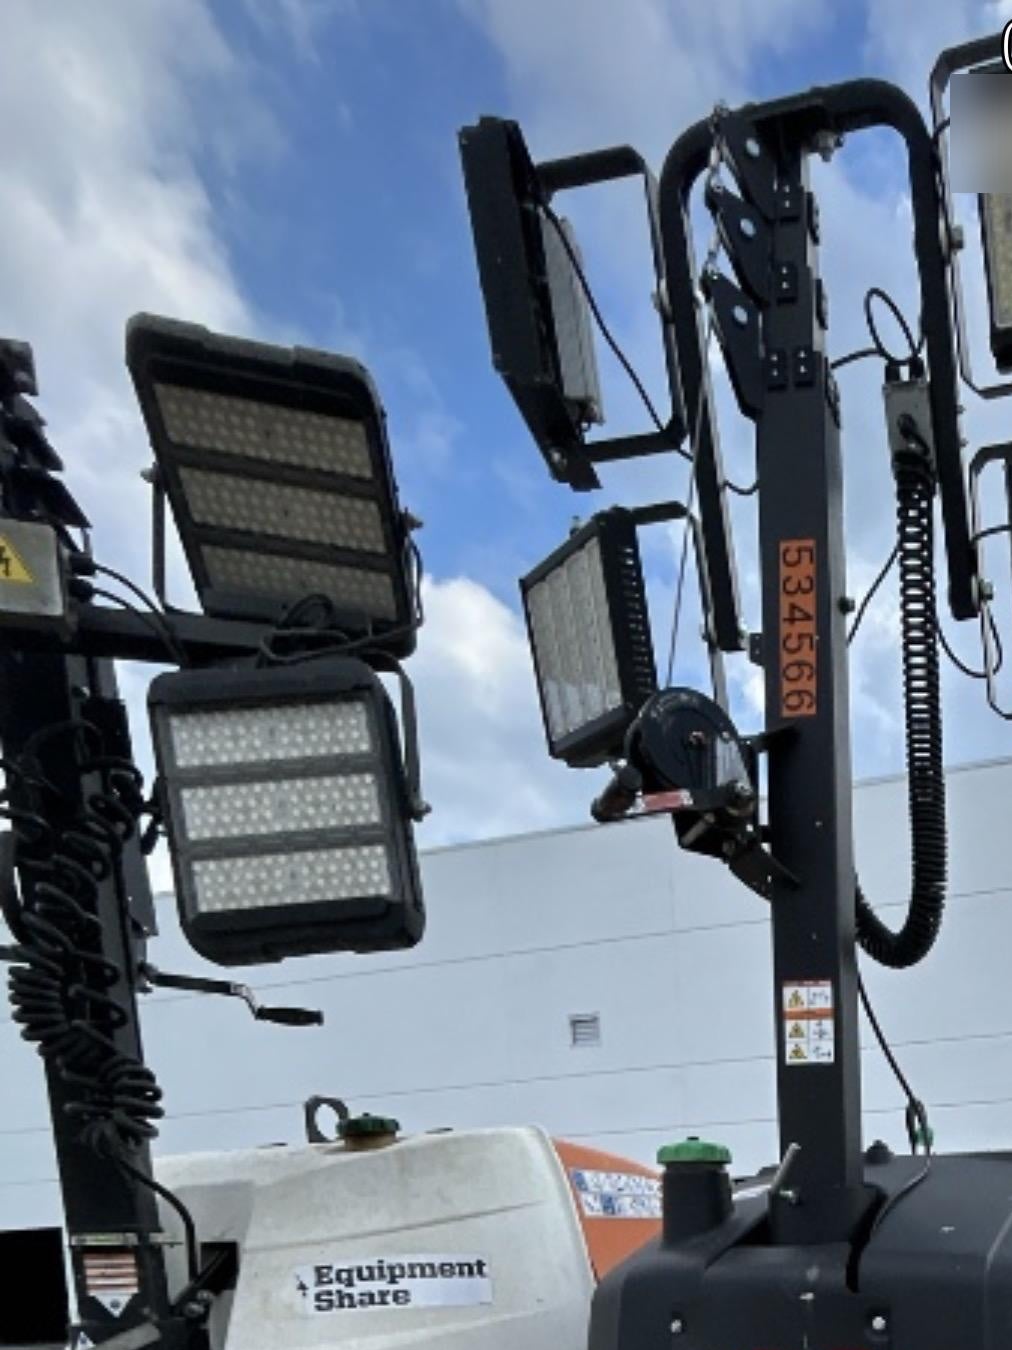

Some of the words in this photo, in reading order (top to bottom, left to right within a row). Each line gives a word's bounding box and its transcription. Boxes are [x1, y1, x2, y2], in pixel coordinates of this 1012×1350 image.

[782, 546, 814, 711] 534566
[314, 1259, 487, 1287] Equipment
[314, 1289, 411, 1312] Share
